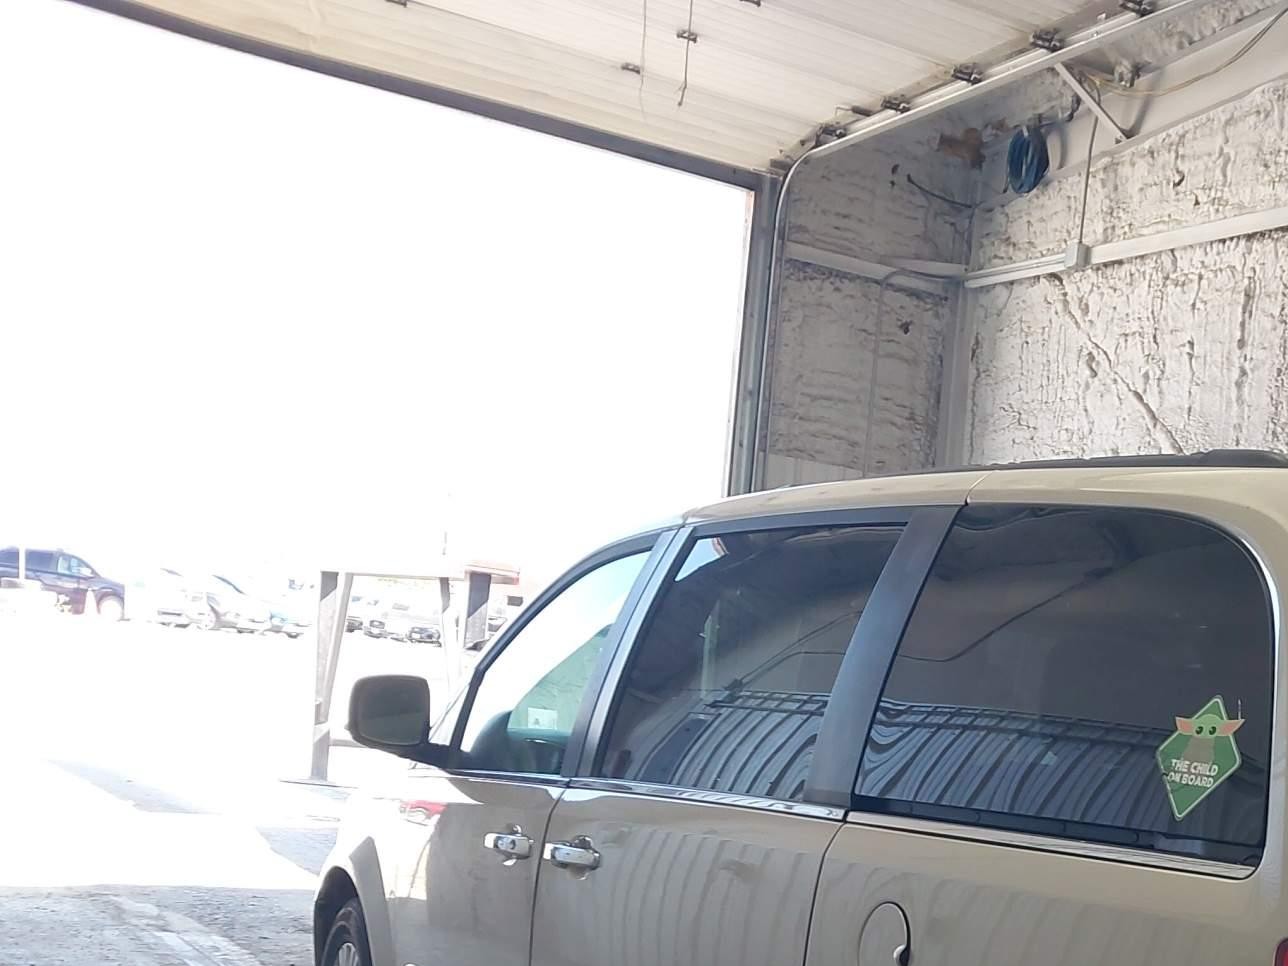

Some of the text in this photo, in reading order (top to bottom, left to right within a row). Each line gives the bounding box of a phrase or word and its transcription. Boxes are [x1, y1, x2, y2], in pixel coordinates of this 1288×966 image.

[1171, 758, 1219, 776] THE CHILD
[1167, 771, 1214, 788] ON BOARD
